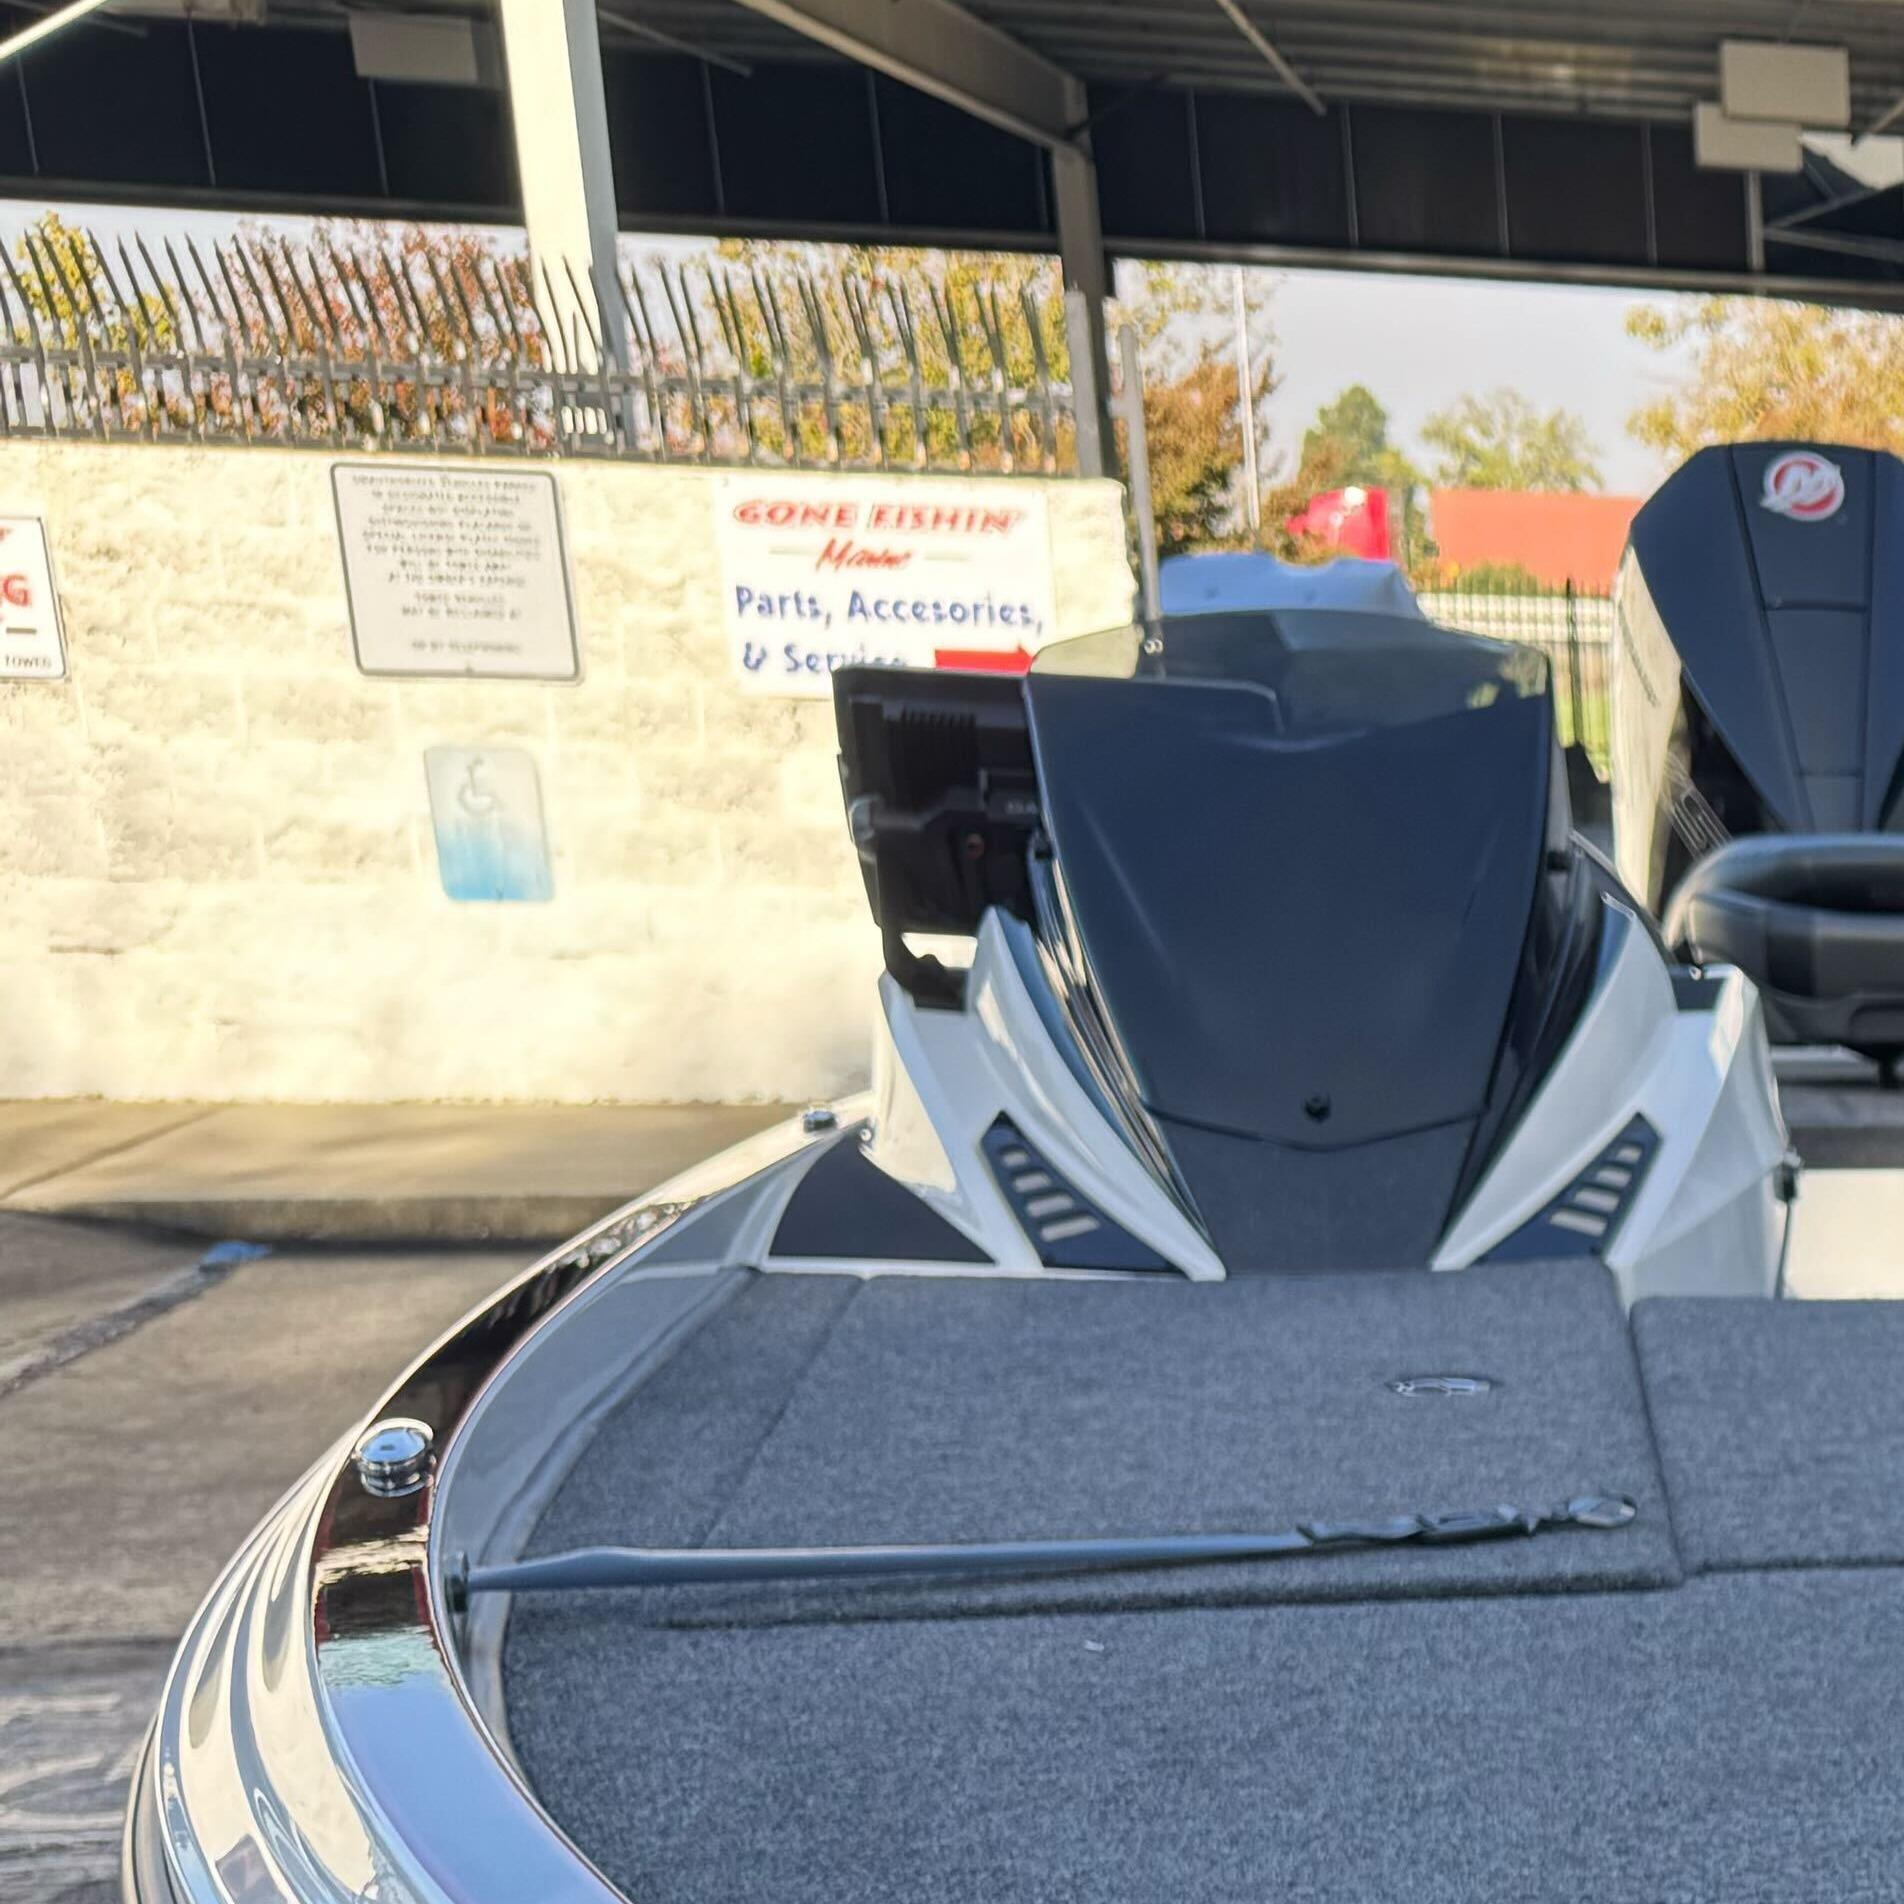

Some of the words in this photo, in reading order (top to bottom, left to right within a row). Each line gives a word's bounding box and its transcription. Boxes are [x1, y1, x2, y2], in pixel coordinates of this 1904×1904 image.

[733, 499, 857, 530] GONE
[735, 585, 833, 629] Parts,
[847, 590, 1043, 635] Accesories,
